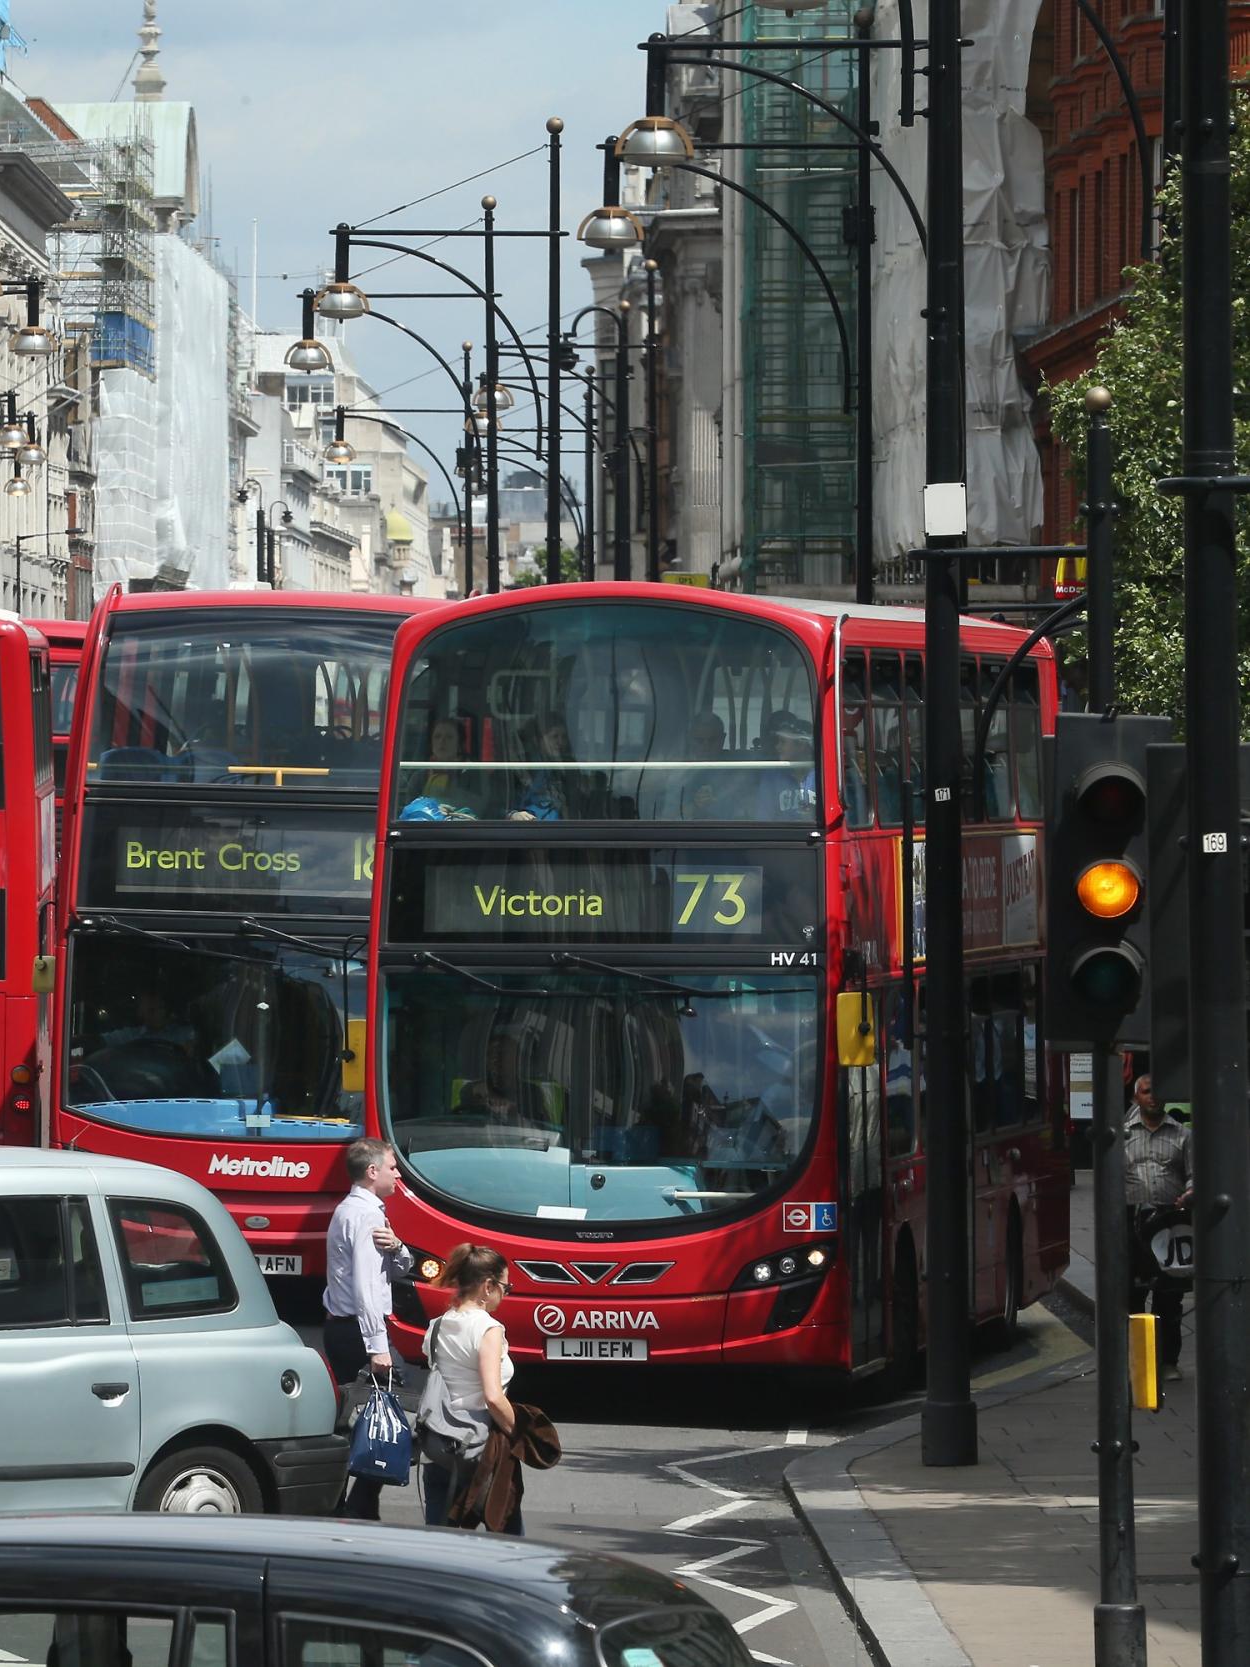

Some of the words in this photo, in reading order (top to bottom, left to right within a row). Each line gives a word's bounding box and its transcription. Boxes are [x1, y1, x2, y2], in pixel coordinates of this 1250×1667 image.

[936, 789, 949, 800] 171
[1205, 835, 1224, 851] 169
[126, 841, 206, 870] Brent
[218, 843, 301, 872] Cross
[474, 885, 603, 916] Victoria
[676, 874, 746, 926] 73
[771, 952, 795, 966] HV
[799, 952, 817, 966] 41
[208, 1153, 310, 1179] Metroline
[575, 1231, 615, 1239] VOLVO
[265, 1256, 296, 1272] AFN
[571, 1310, 660, 1329] ARRIVA
[561, 1340, 593, 1358] LJ11
[598, 1341, 633, 1358] EFM
[369, 1407, 402, 1444] GAP
